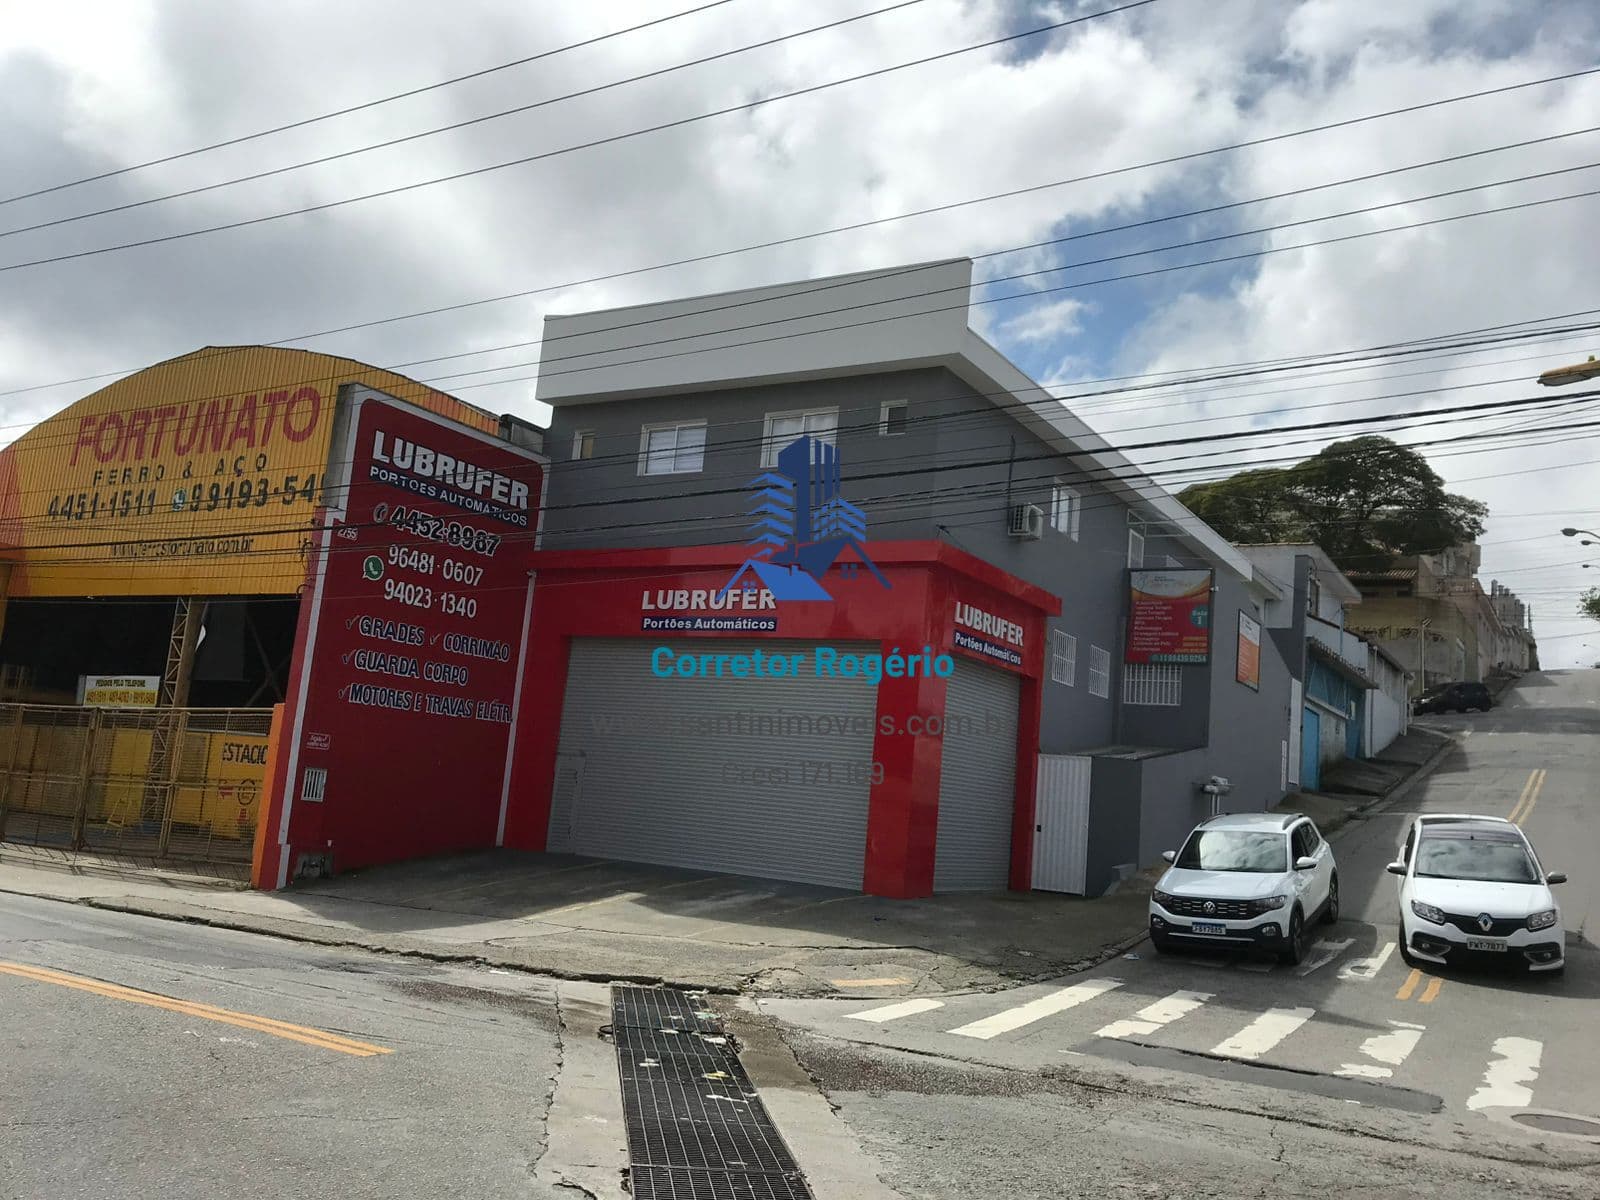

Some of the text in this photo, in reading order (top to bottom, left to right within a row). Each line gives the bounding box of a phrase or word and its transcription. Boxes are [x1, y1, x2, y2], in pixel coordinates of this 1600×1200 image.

[69, 387, 321, 467] FORTUNATO
[92, 463, 166, 487] FERRO
[214, 453, 267, 477] AÇO
[372, 430, 529, 510] LUBRUFER
[641, 588, 777, 610] LUBRUFER
[359, 616, 425, 646] GRADES
[643, 618, 775, 630] Portões Automáticos
[954, 601, 1024, 646] LUBRUFER
[355, 649, 469, 687] GUARDA CORPO
[349, 683, 411, 711] MOTORES
[414, 693, 424, 712] E
[426, 694, 474, 718] TRAVAS
